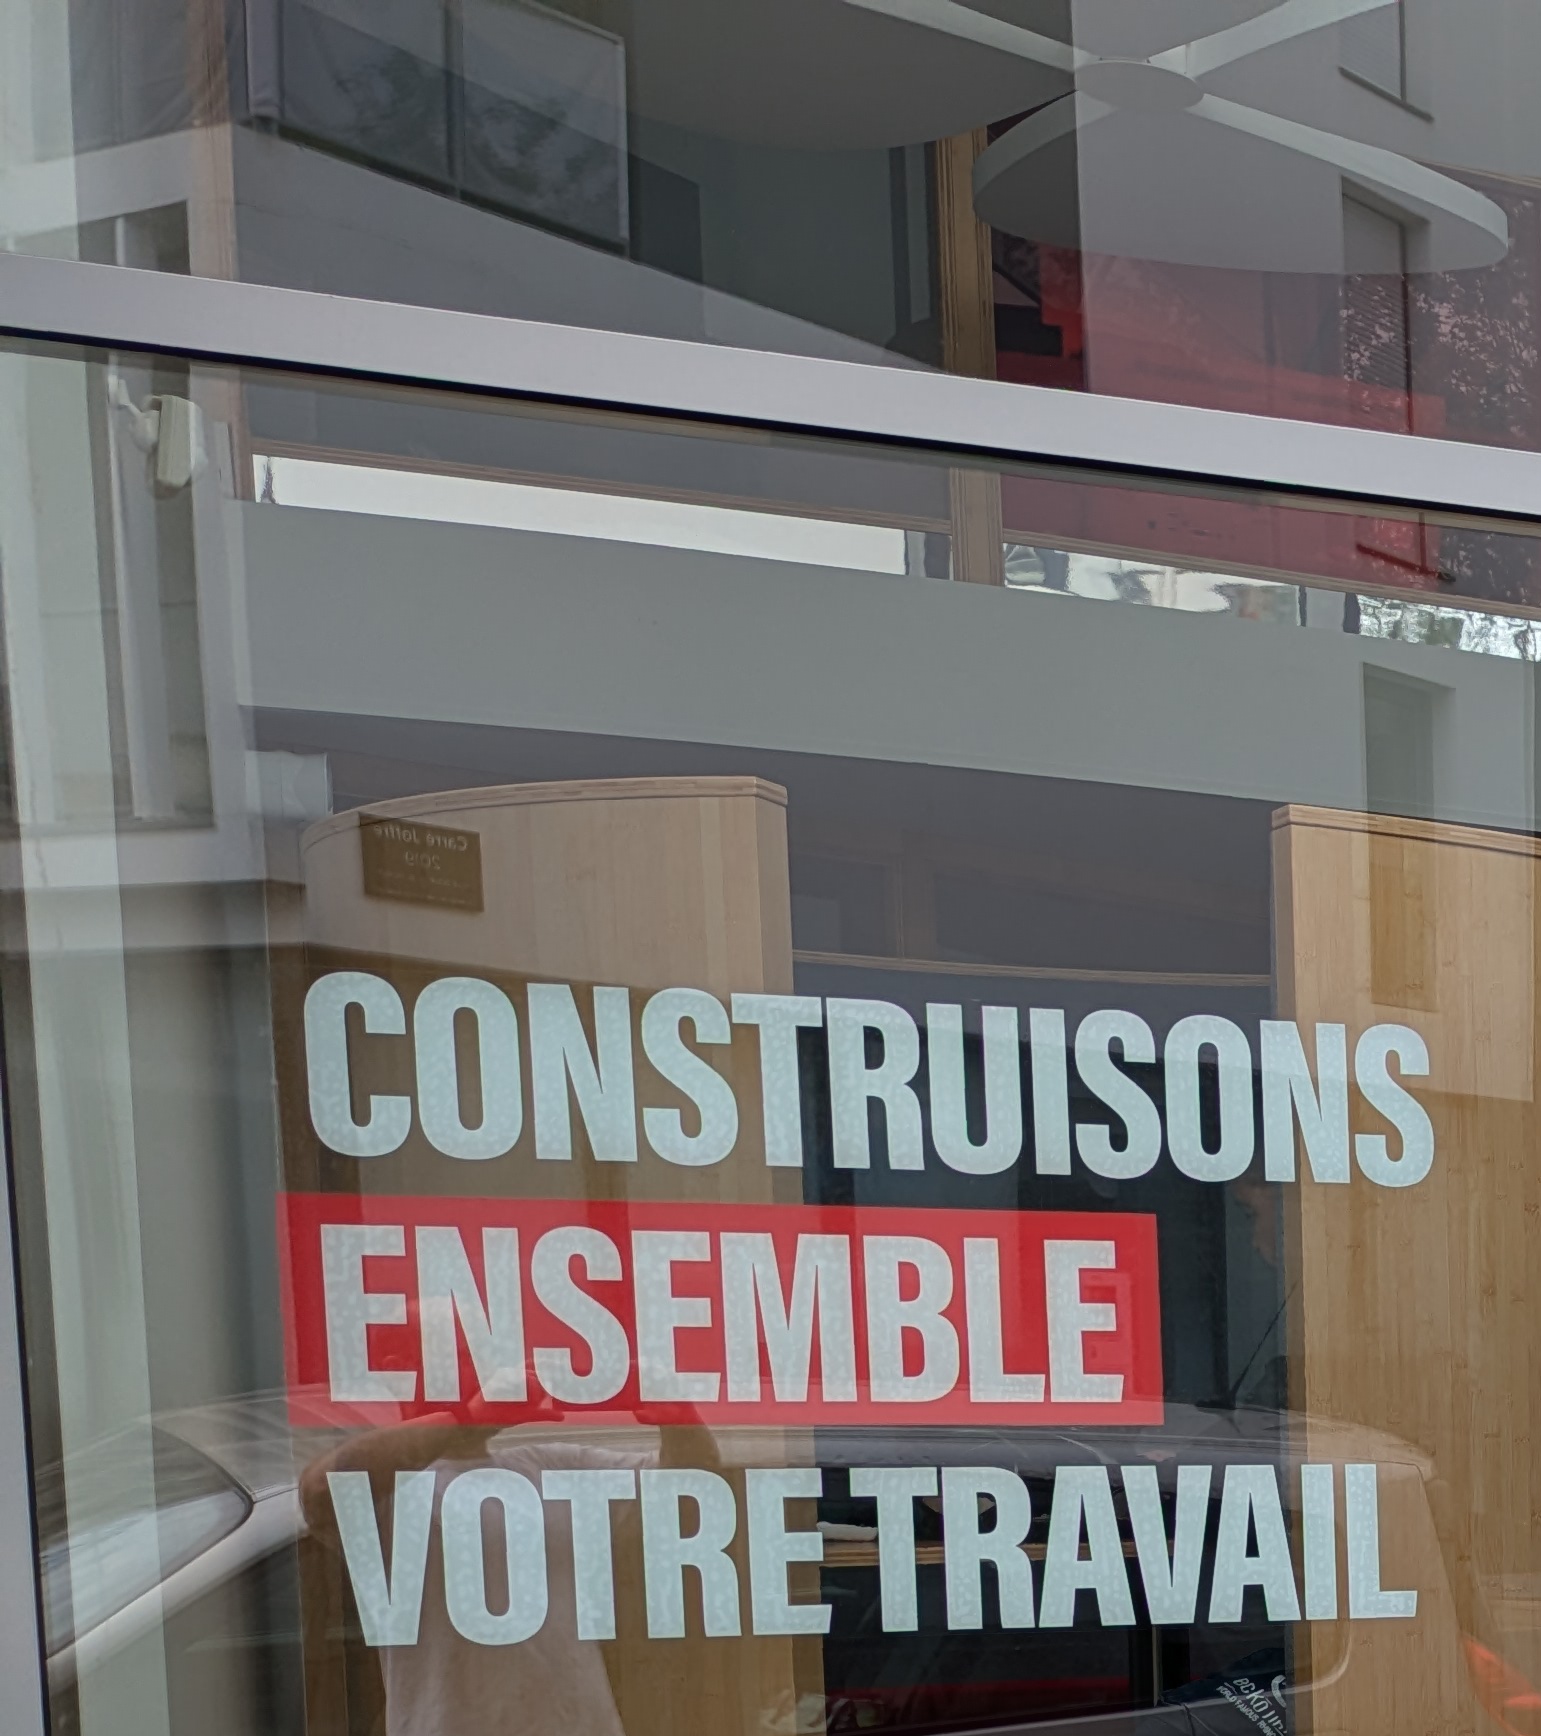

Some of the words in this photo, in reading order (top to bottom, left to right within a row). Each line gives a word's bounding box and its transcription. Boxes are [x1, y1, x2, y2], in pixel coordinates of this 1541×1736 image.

[304, 970, 1435, 1187] CONSTRUISONS
[320, 1224, 1124, 1404] ENSEMBLE
[326, 1466, 833, 1647] VOTRE
[850, 1463, 1418, 1632] TRAVAIL
